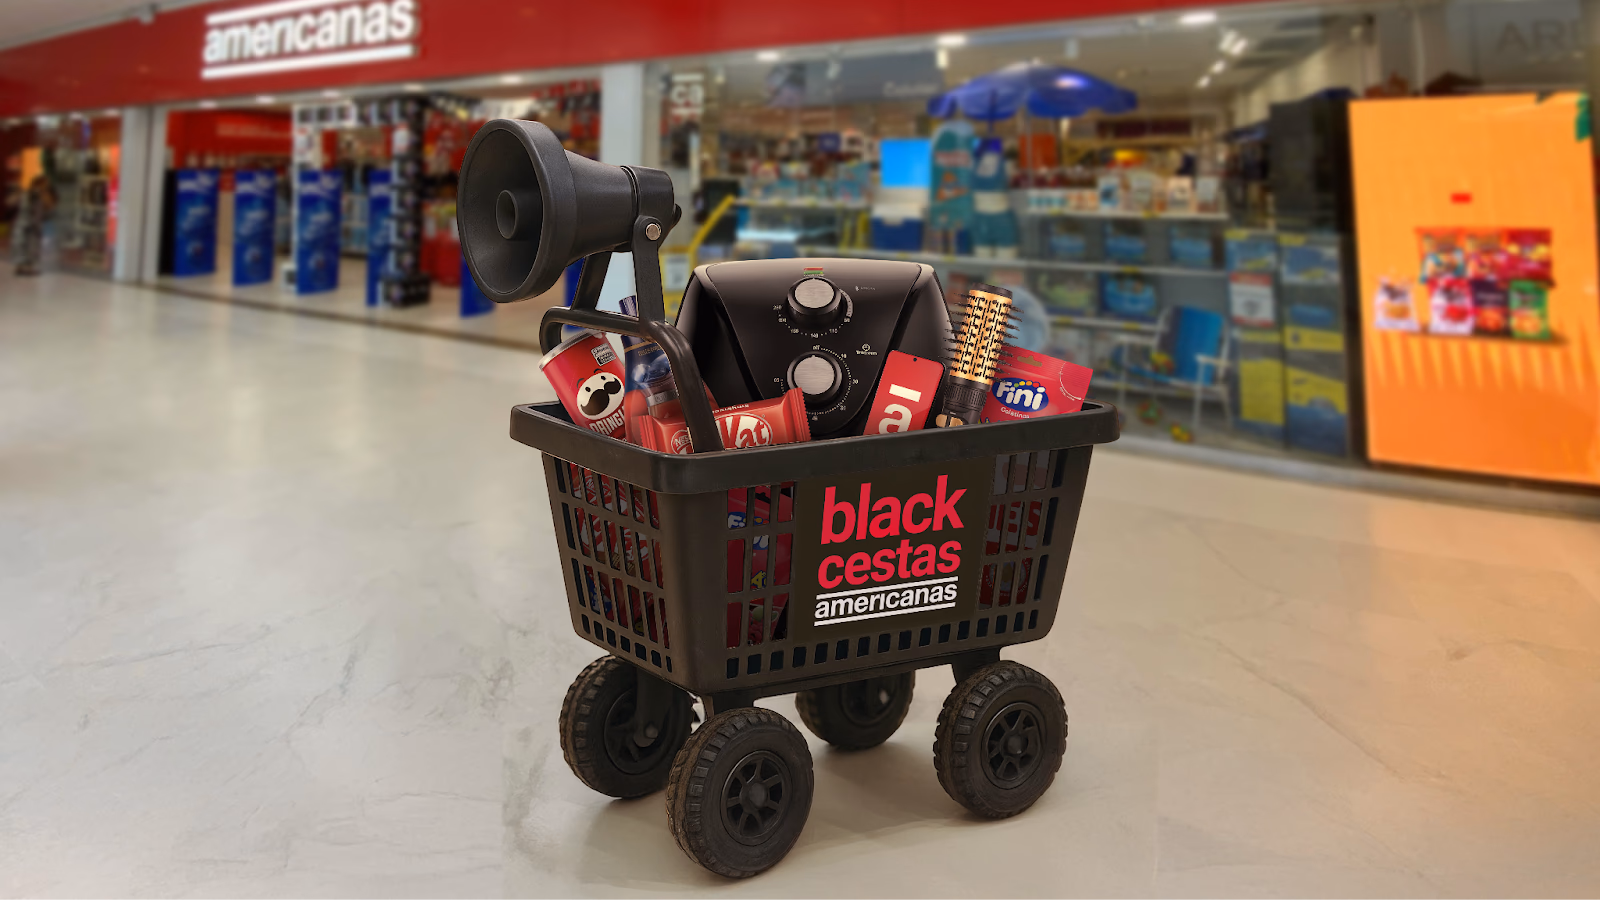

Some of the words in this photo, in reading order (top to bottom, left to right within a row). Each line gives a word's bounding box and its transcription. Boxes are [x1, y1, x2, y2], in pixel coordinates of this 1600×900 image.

[203, 0, 415, 62] americanas
[820, 474, 967, 545] black
[817, 539, 962, 589] cestas
[814, 583, 957, 619] americanas
